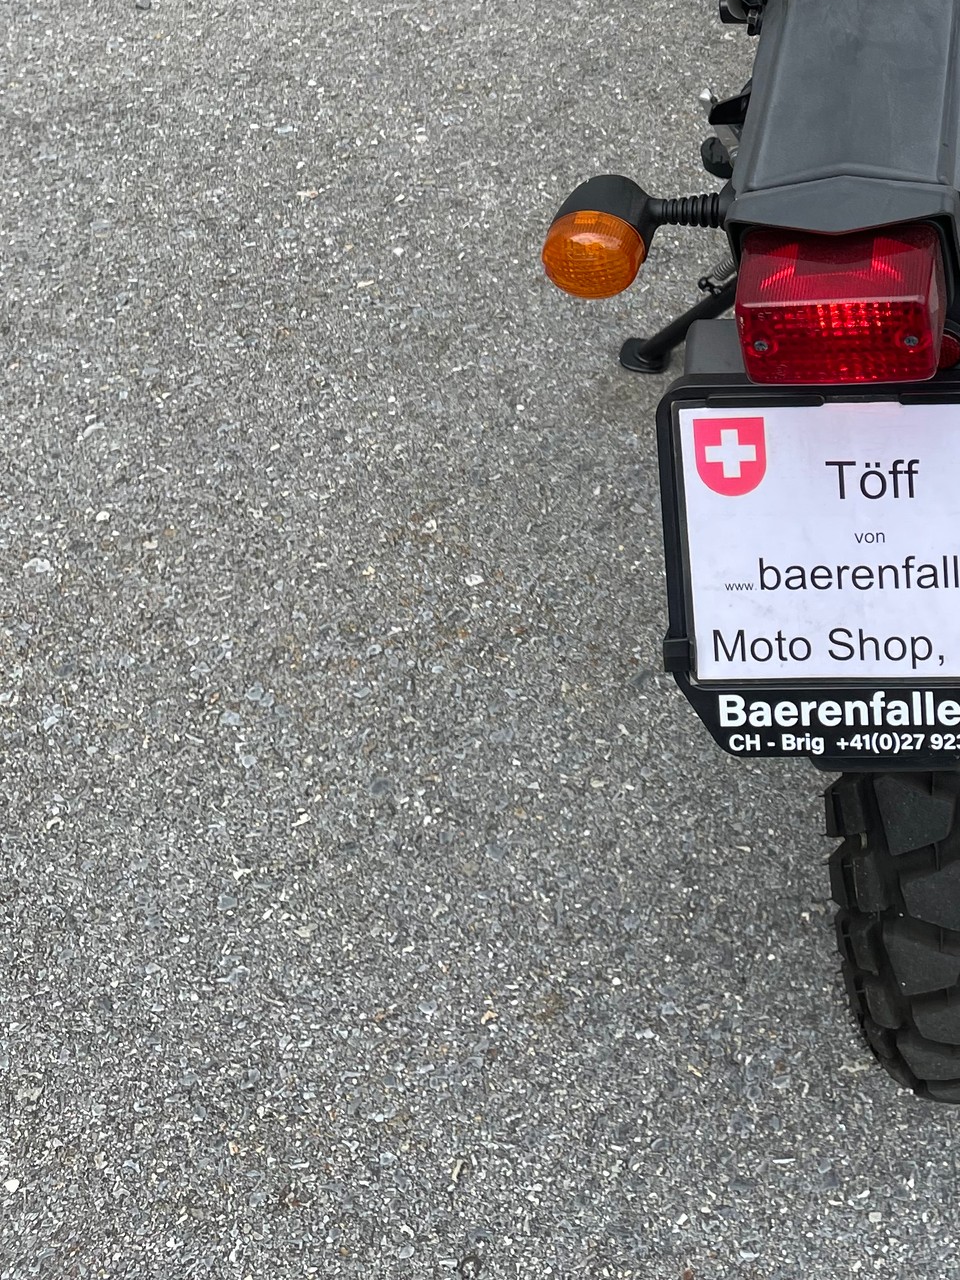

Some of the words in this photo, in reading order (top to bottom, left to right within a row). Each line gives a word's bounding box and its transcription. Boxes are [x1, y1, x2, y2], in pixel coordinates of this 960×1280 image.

[824, 458, 920, 500] Töff
[854, 532, 886, 544] von
[712, 629, 812, 663] Moto
[828, 626, 944, 670] Shop,
[728, 733, 761, 752] CH
[781, 732, 825, 755] Brig
[836, 732, 926, 754] +41(0)27
